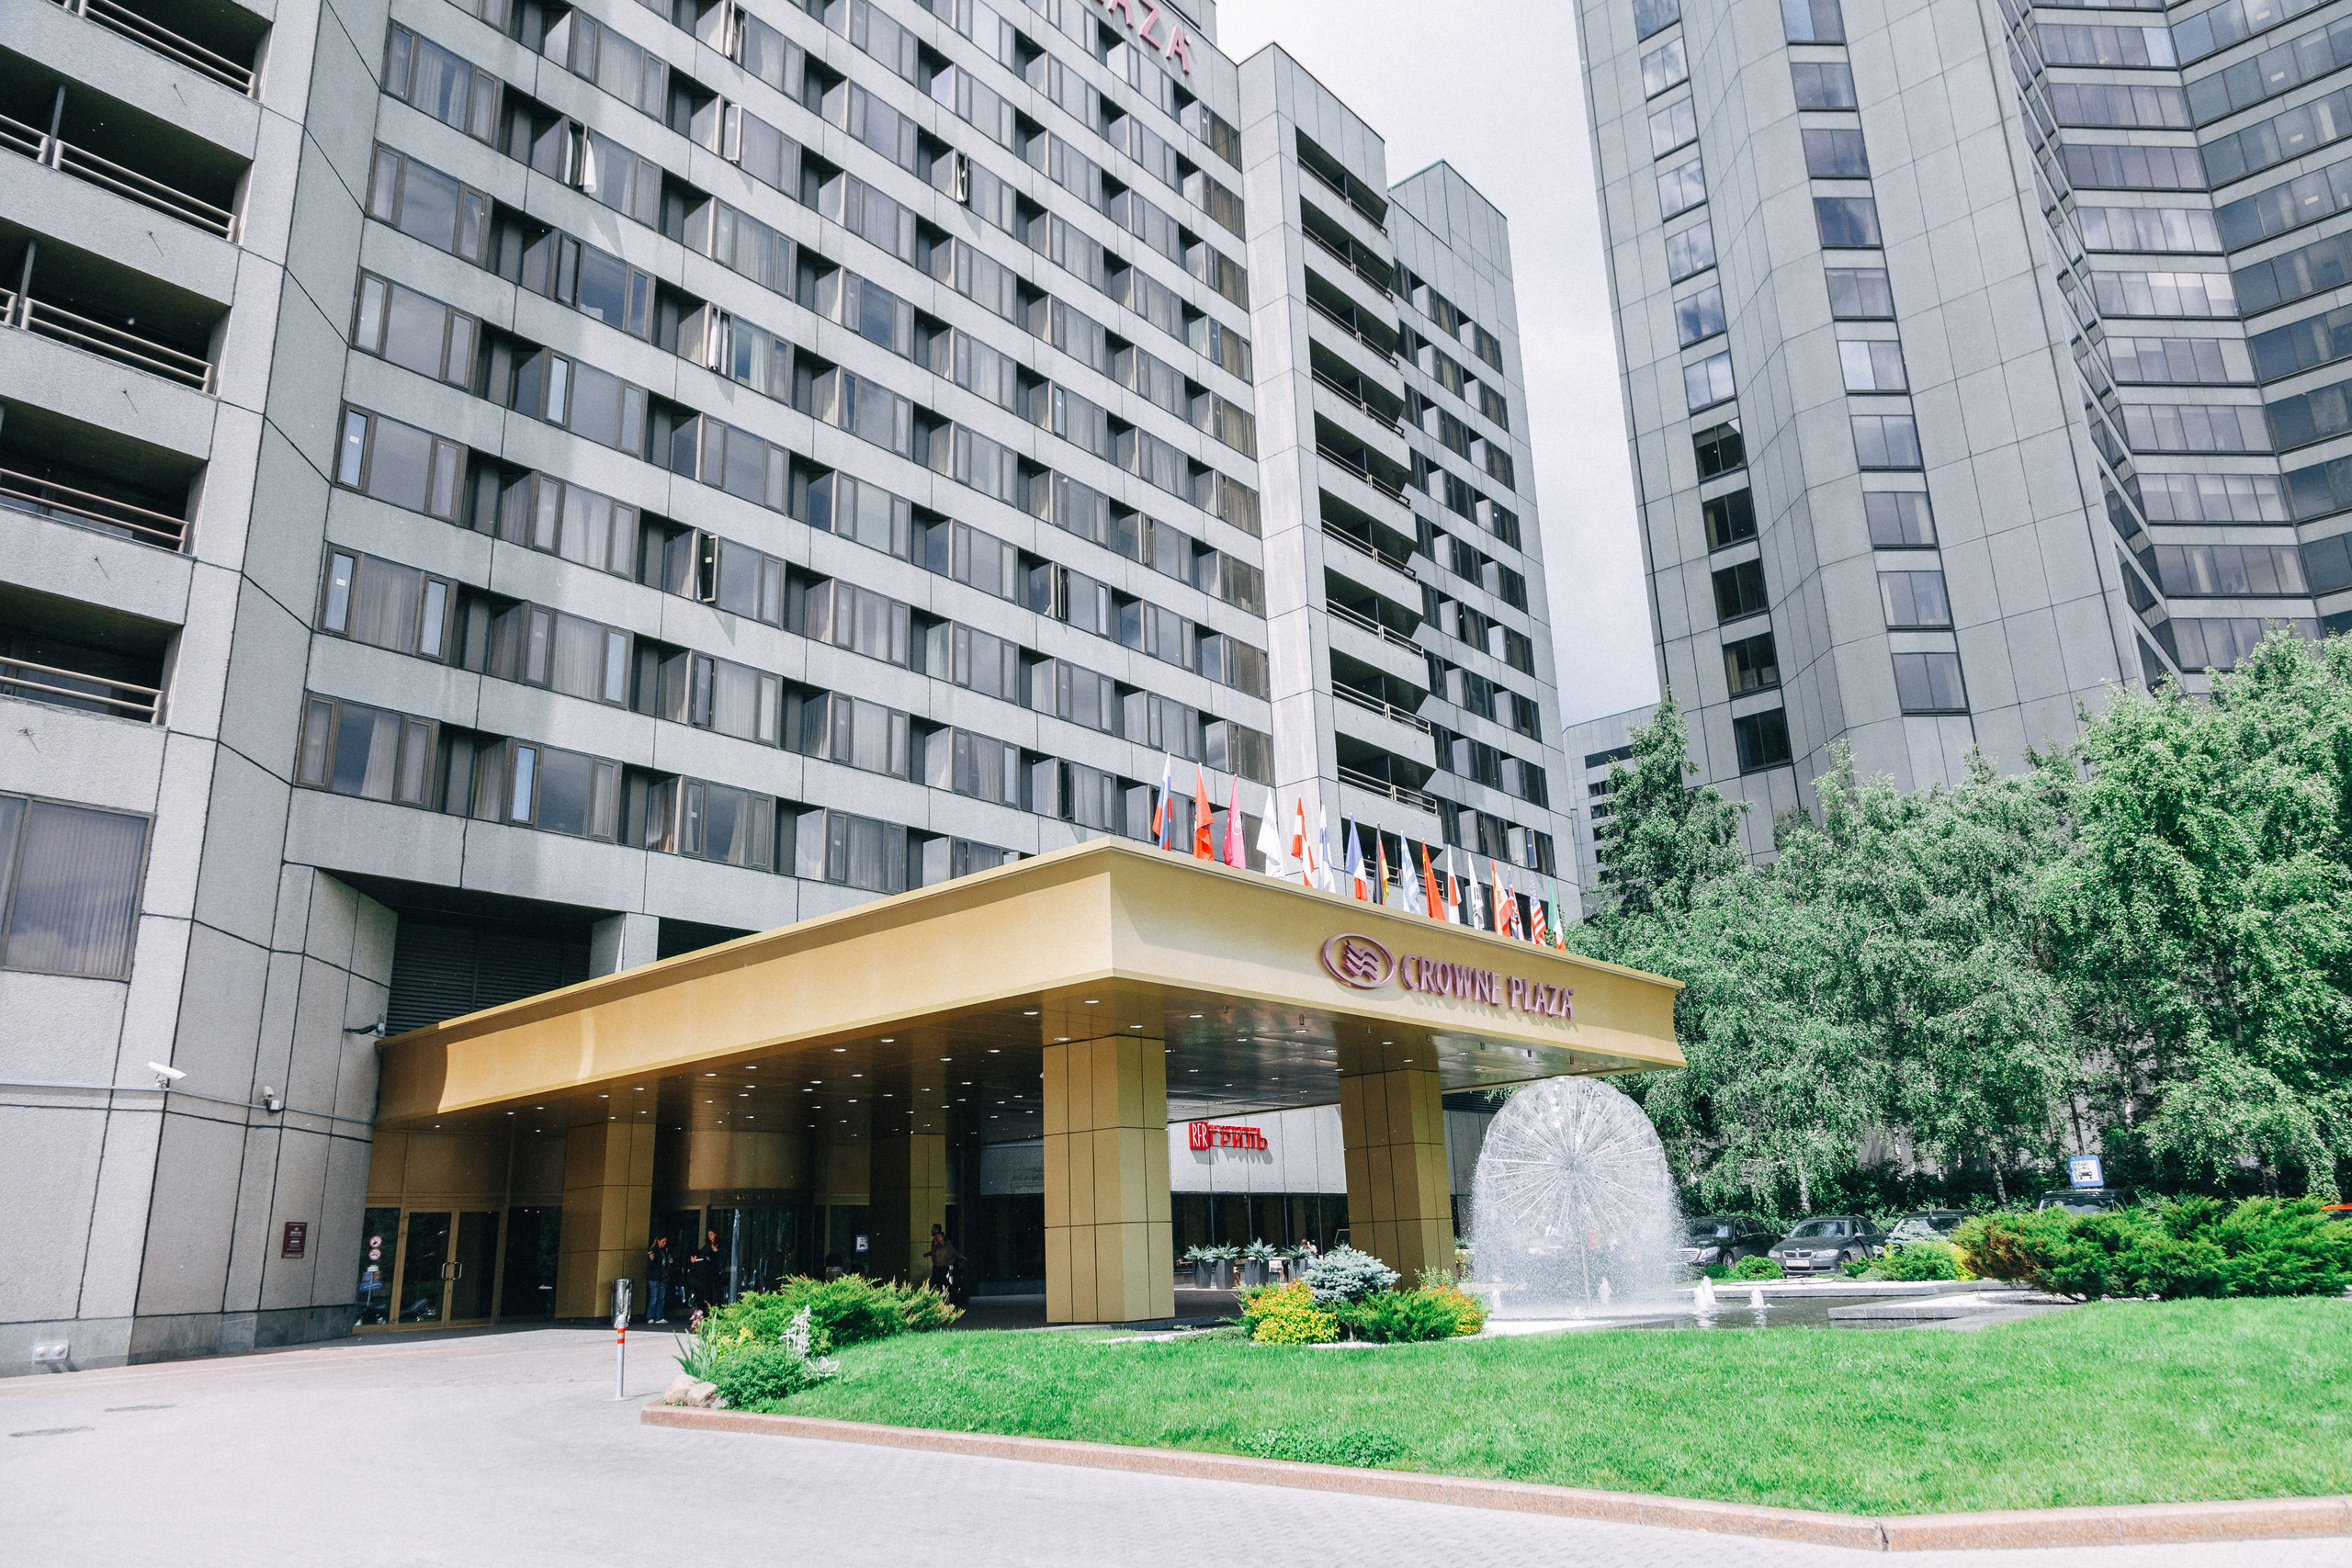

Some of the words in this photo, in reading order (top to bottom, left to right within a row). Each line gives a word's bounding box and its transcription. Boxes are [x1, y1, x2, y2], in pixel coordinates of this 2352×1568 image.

[1093, 0, 1192, 74] AZA
[1402, 953, 1503, 1005] CROWNE
[1508, 976, 1575, 1019] PLAZA
[1192, 1122, 1208, 1147] RFR
[1209, 1127, 1268, 1150] ГРИЛЬ
